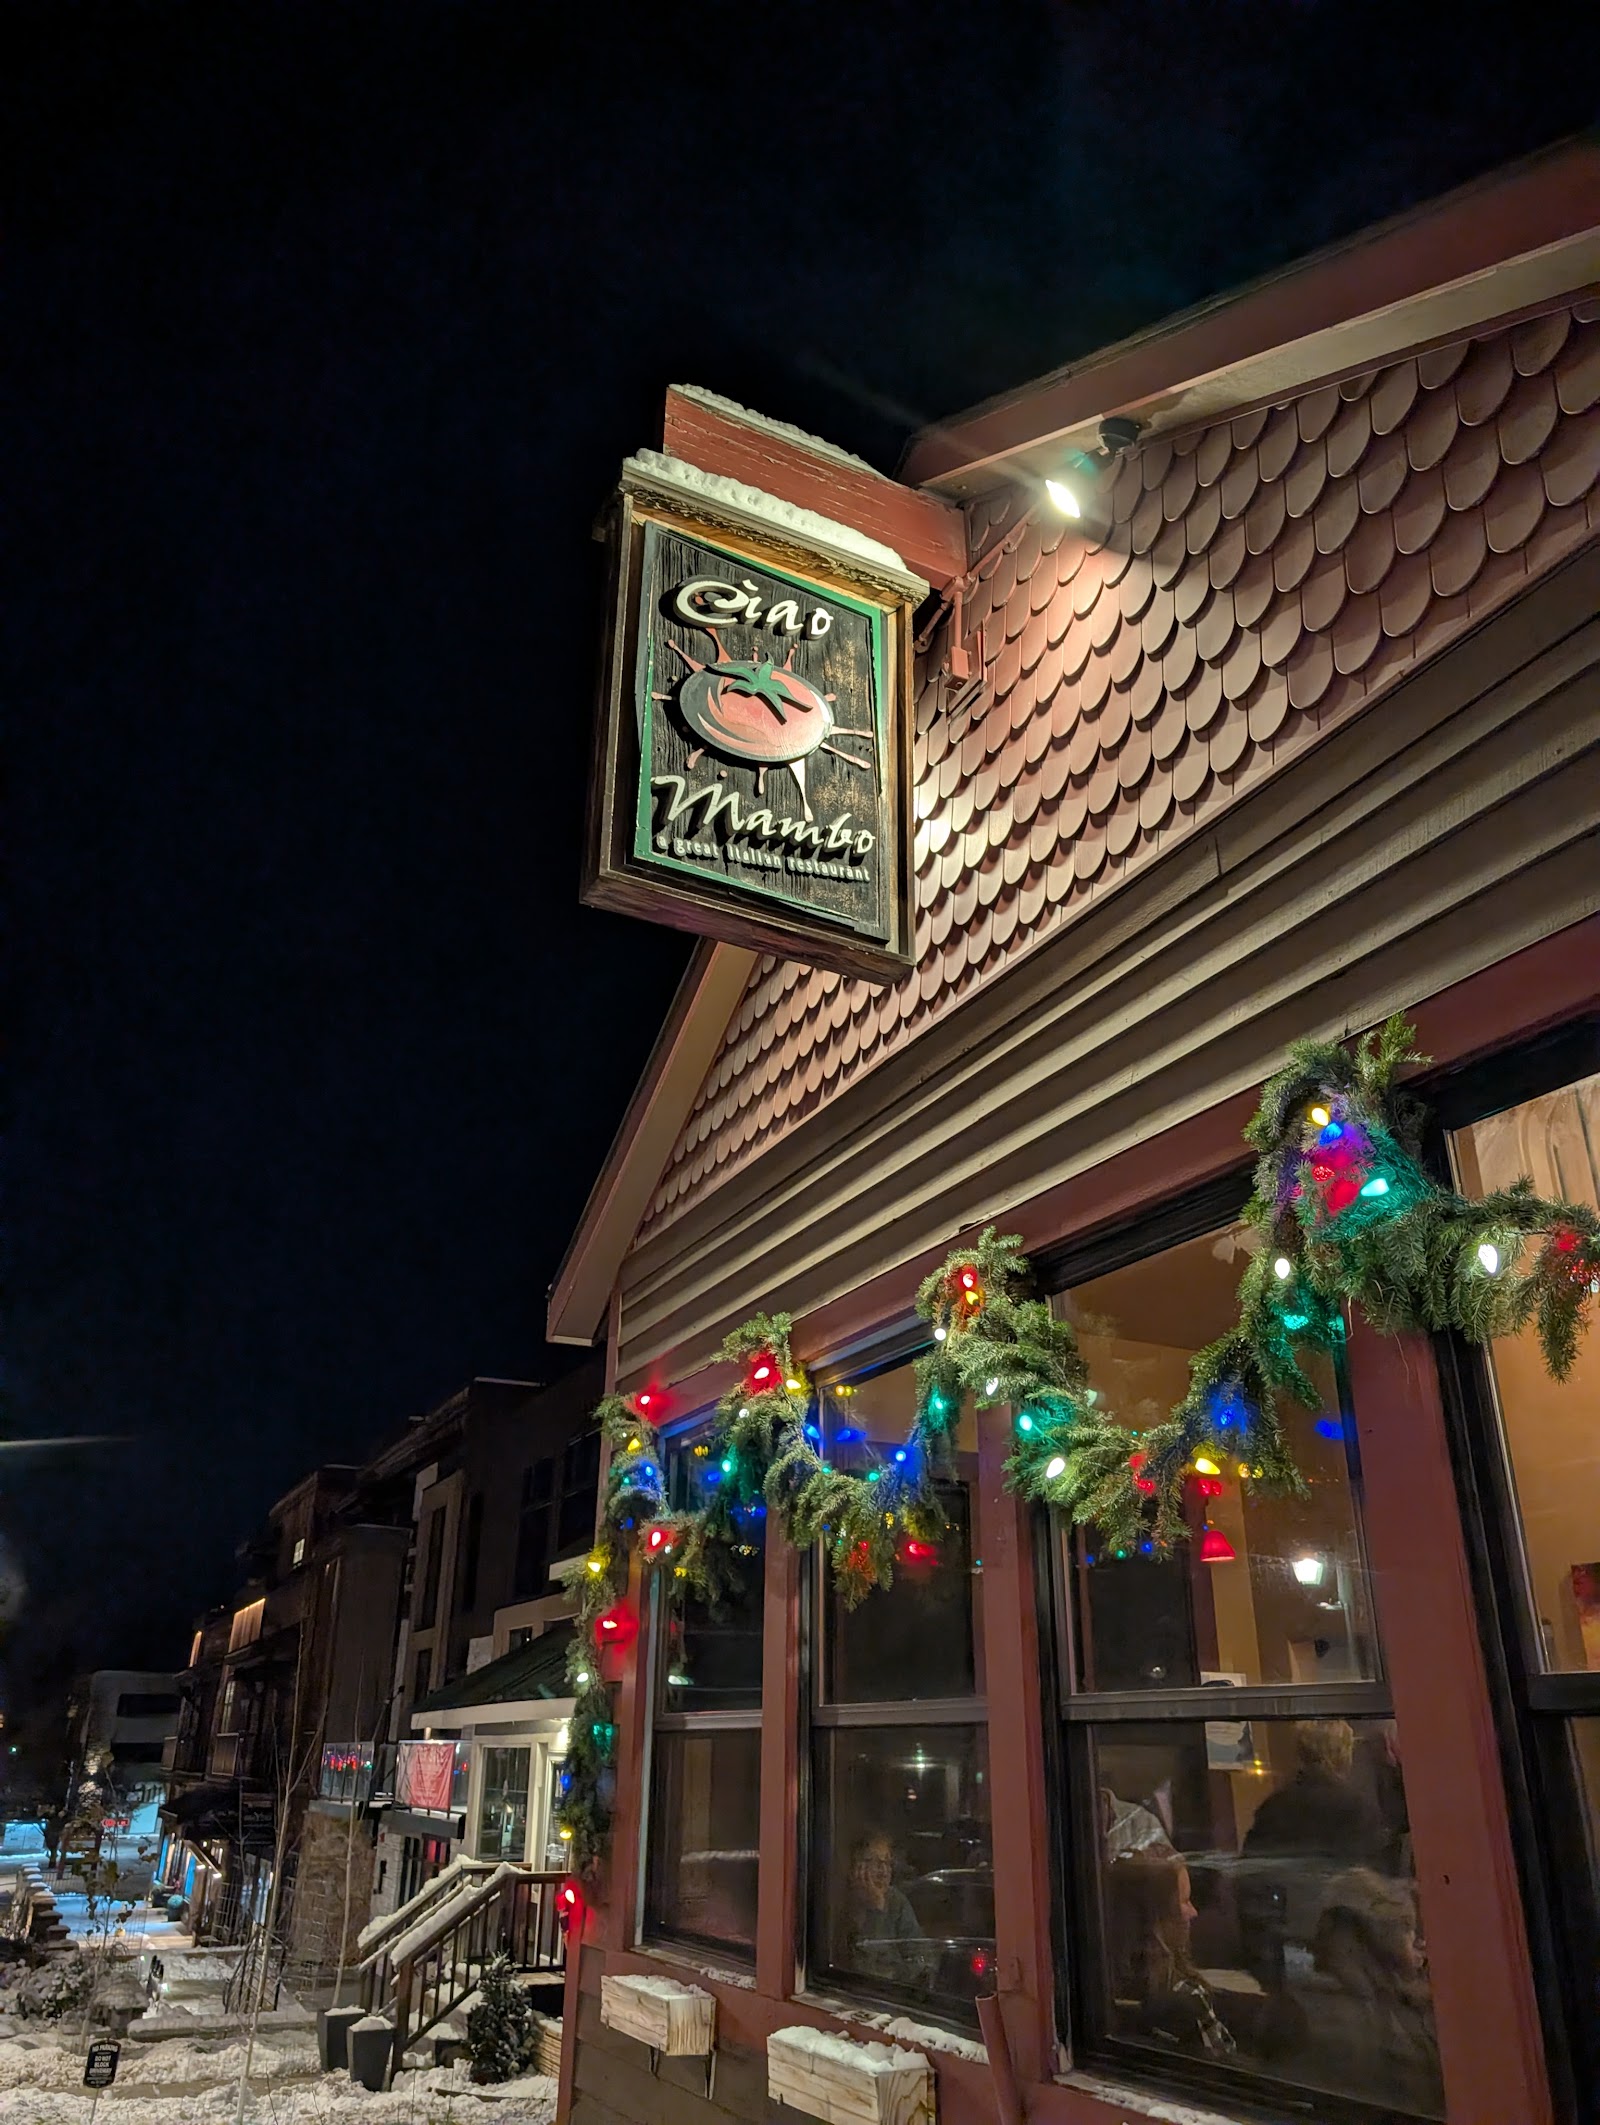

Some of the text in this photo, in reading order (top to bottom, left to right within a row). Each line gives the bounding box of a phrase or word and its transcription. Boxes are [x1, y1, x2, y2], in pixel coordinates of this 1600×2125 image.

[676, 579, 834, 635] Ciao
[650, 775, 876, 854] Mambo
[656, 834, 871, 883] a great Italian restaurant
